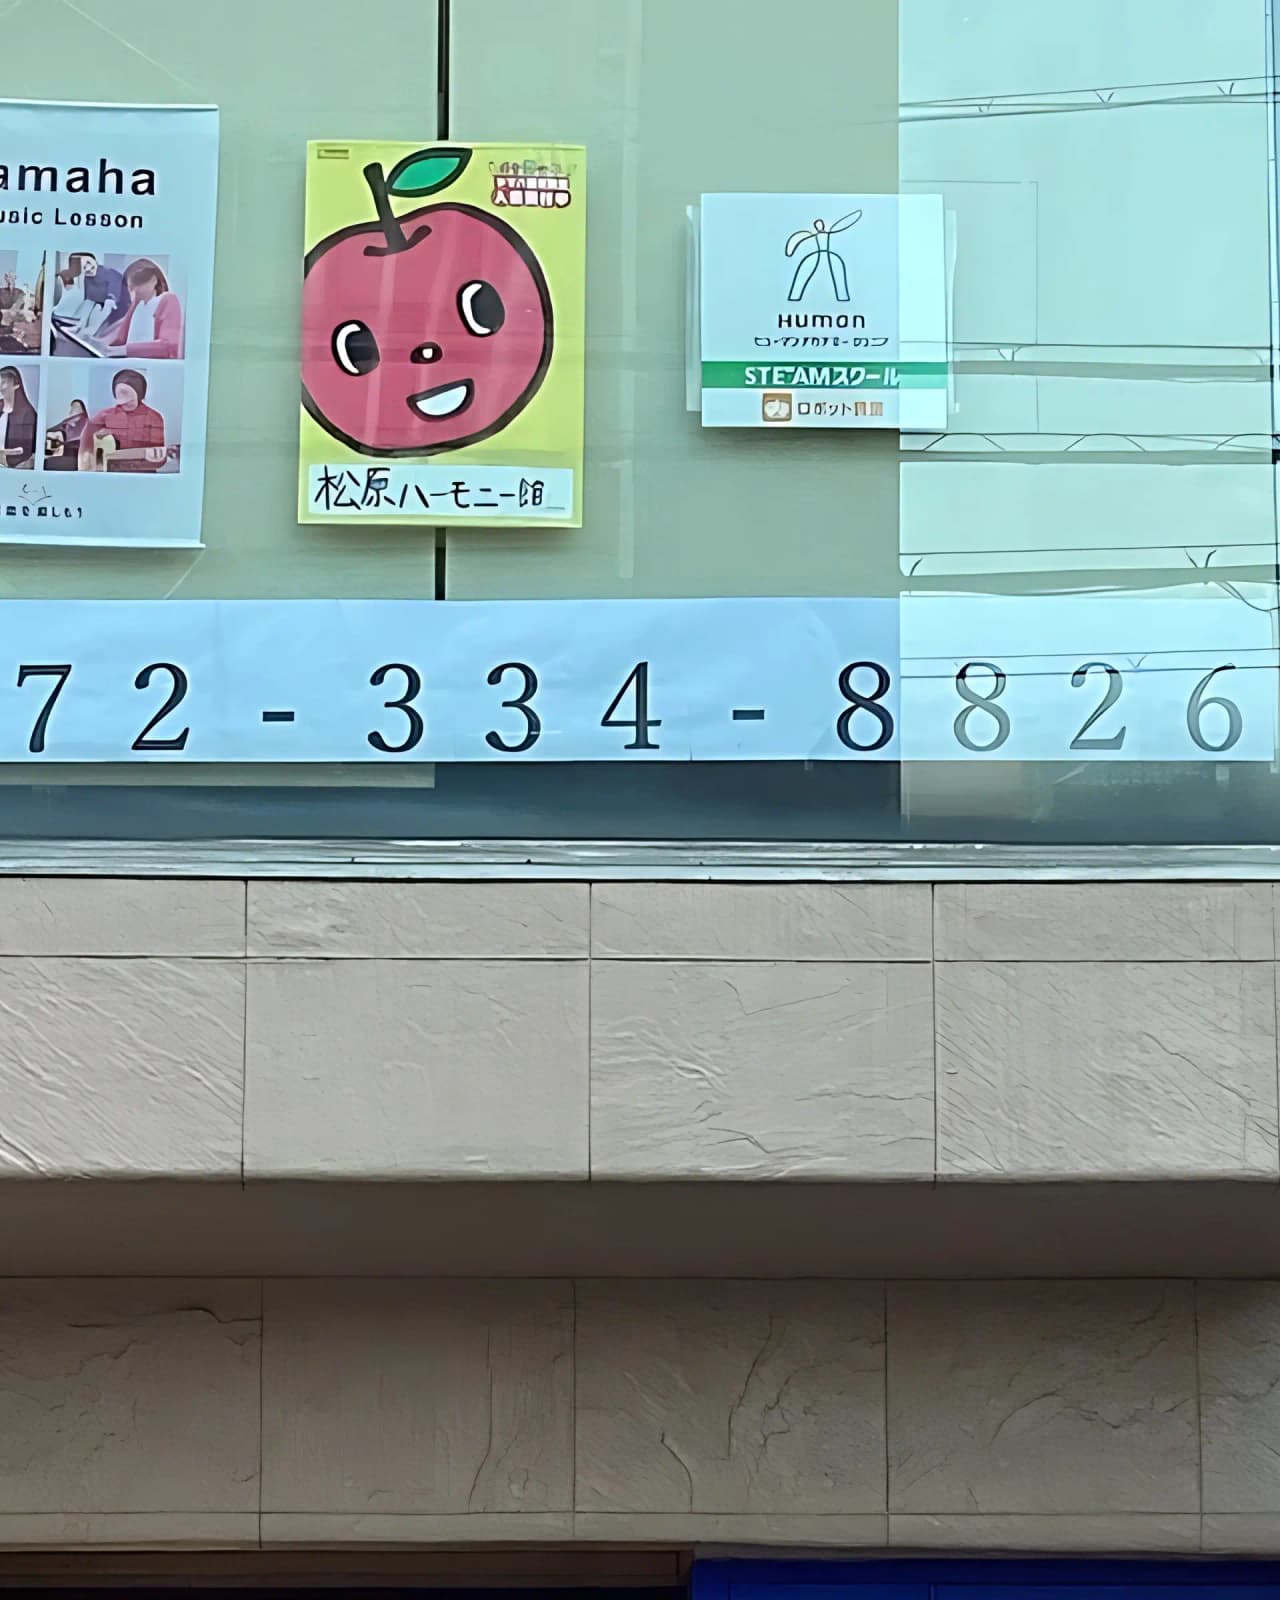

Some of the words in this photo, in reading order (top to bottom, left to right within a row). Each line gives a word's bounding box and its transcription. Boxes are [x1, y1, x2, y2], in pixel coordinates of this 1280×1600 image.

[54, 207, 144, 229] Lesson
[777, 313, 866, 329] Human
[744, 366, 902, 386] STEAMスクール
